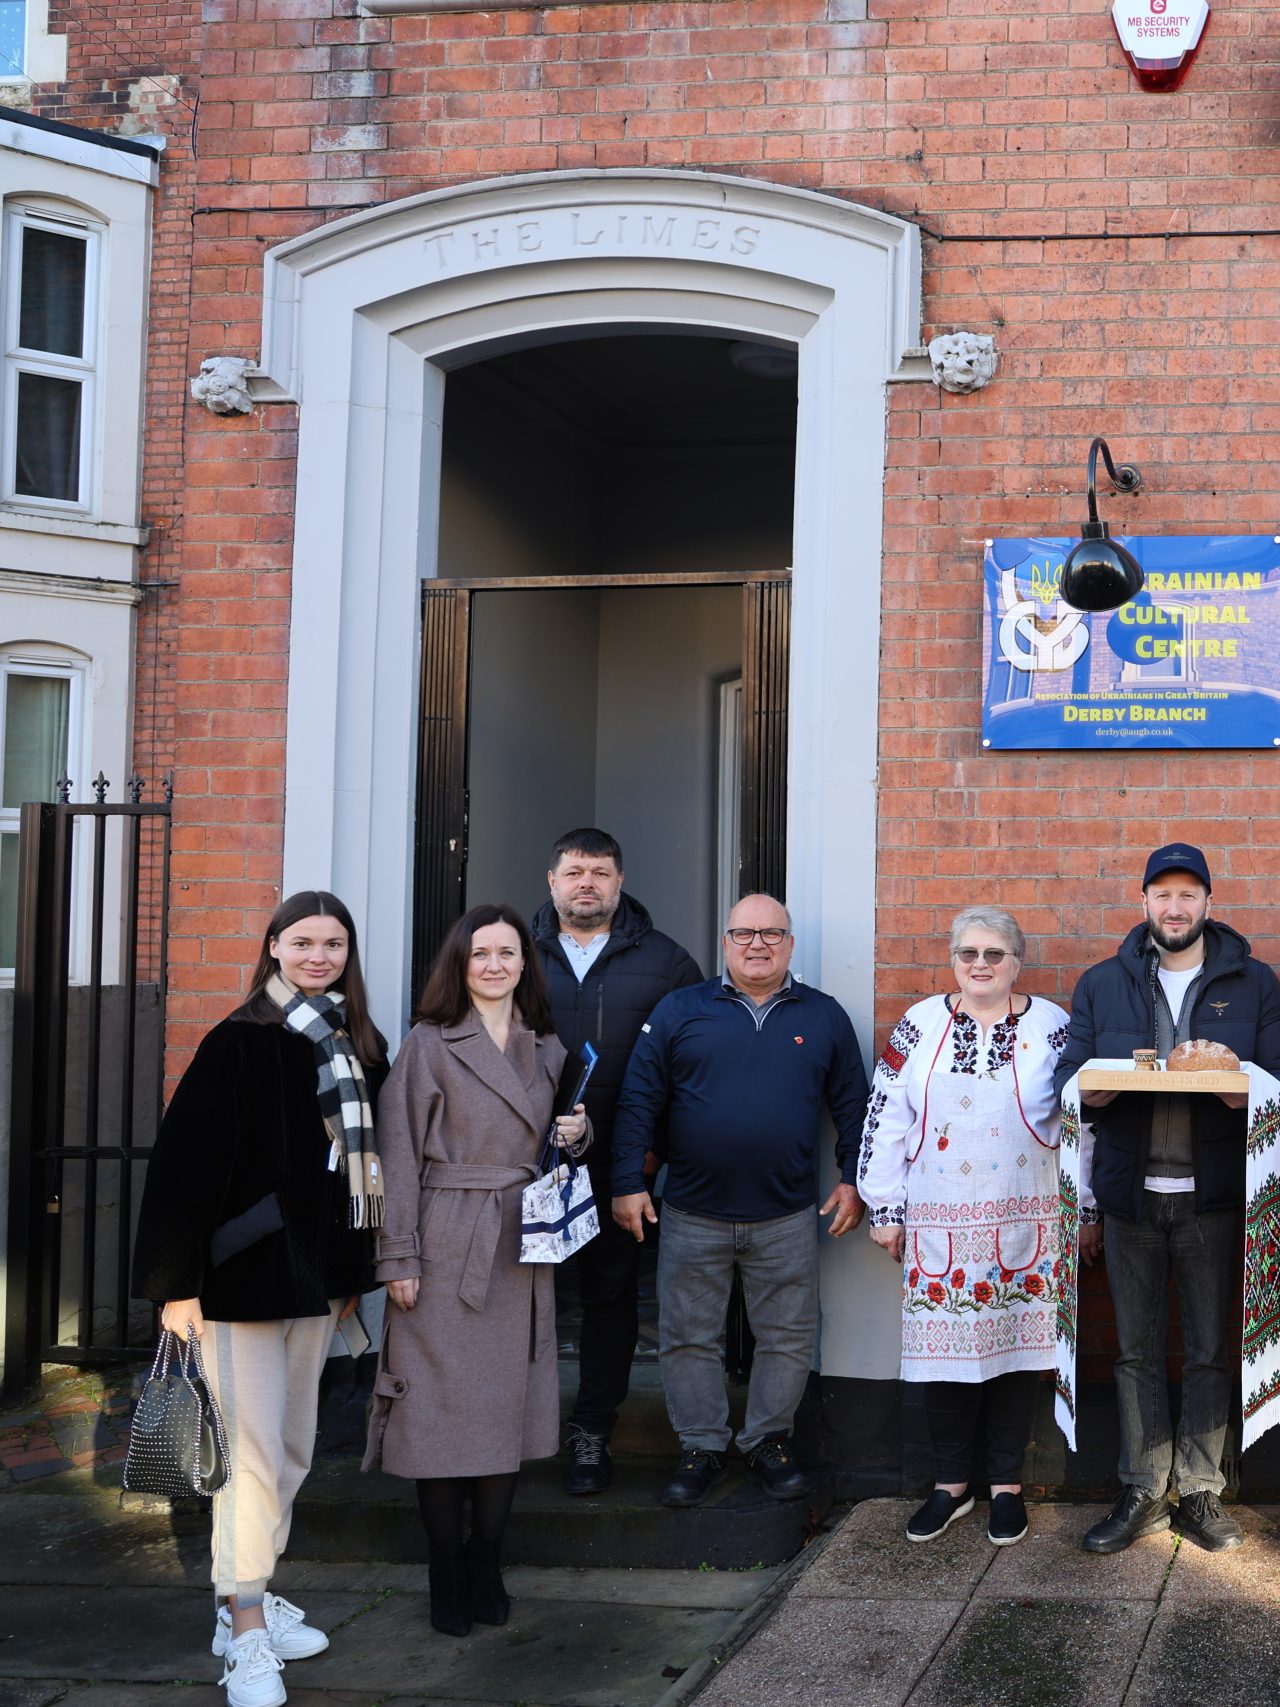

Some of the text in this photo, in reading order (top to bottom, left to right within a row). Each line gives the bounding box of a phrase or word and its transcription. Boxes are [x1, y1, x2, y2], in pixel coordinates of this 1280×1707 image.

[1128, 16, 1191, 27] MB SECURITY
[1137, 27, 1181, 37] SYSTEMS
[423, 212, 761, 270] THE LIMES
[1141, 572, 1261, 591] RAINIAN
[1118, 602, 1251, 625] CULTURAL
[1135, 635, 1238, 658] CENTRE
[1034, 692, 1089, 700] ASSOCIATION
[1101, 691, 1154, 700] UKRAINIANS
[1165, 691, 1192, 700] GREAT
[1193, 691, 1229, 700] BRITAIN
[1063, 705, 1207, 722] DERBY BRANCH
[1095, 727, 1174, 737] derby@augb.co.uk
[1108, 1074, 1175, 1085] BREAKFAST
[1196, 1075, 1220, 1086] BED
